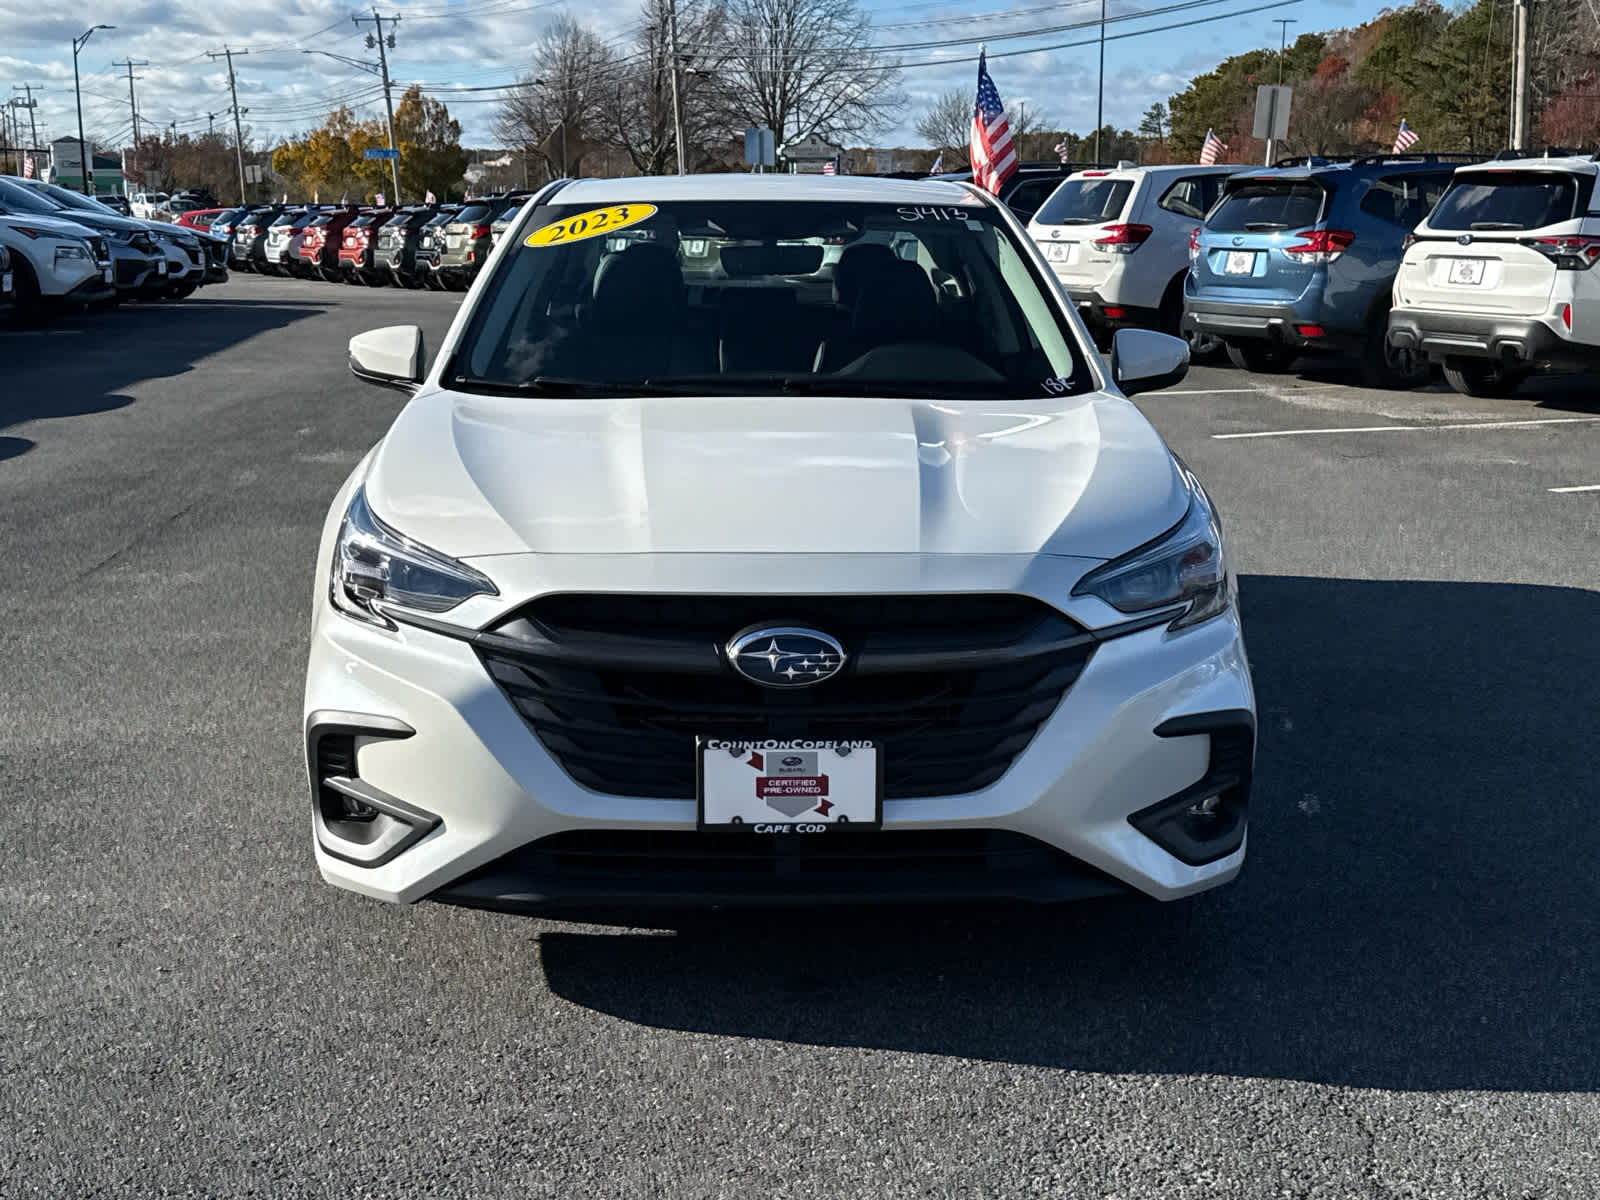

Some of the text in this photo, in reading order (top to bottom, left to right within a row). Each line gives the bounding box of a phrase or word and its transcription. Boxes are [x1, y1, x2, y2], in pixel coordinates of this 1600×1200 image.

[550, 207, 629, 242] 2023
[753, 823, 826, 833] CAPE COD
